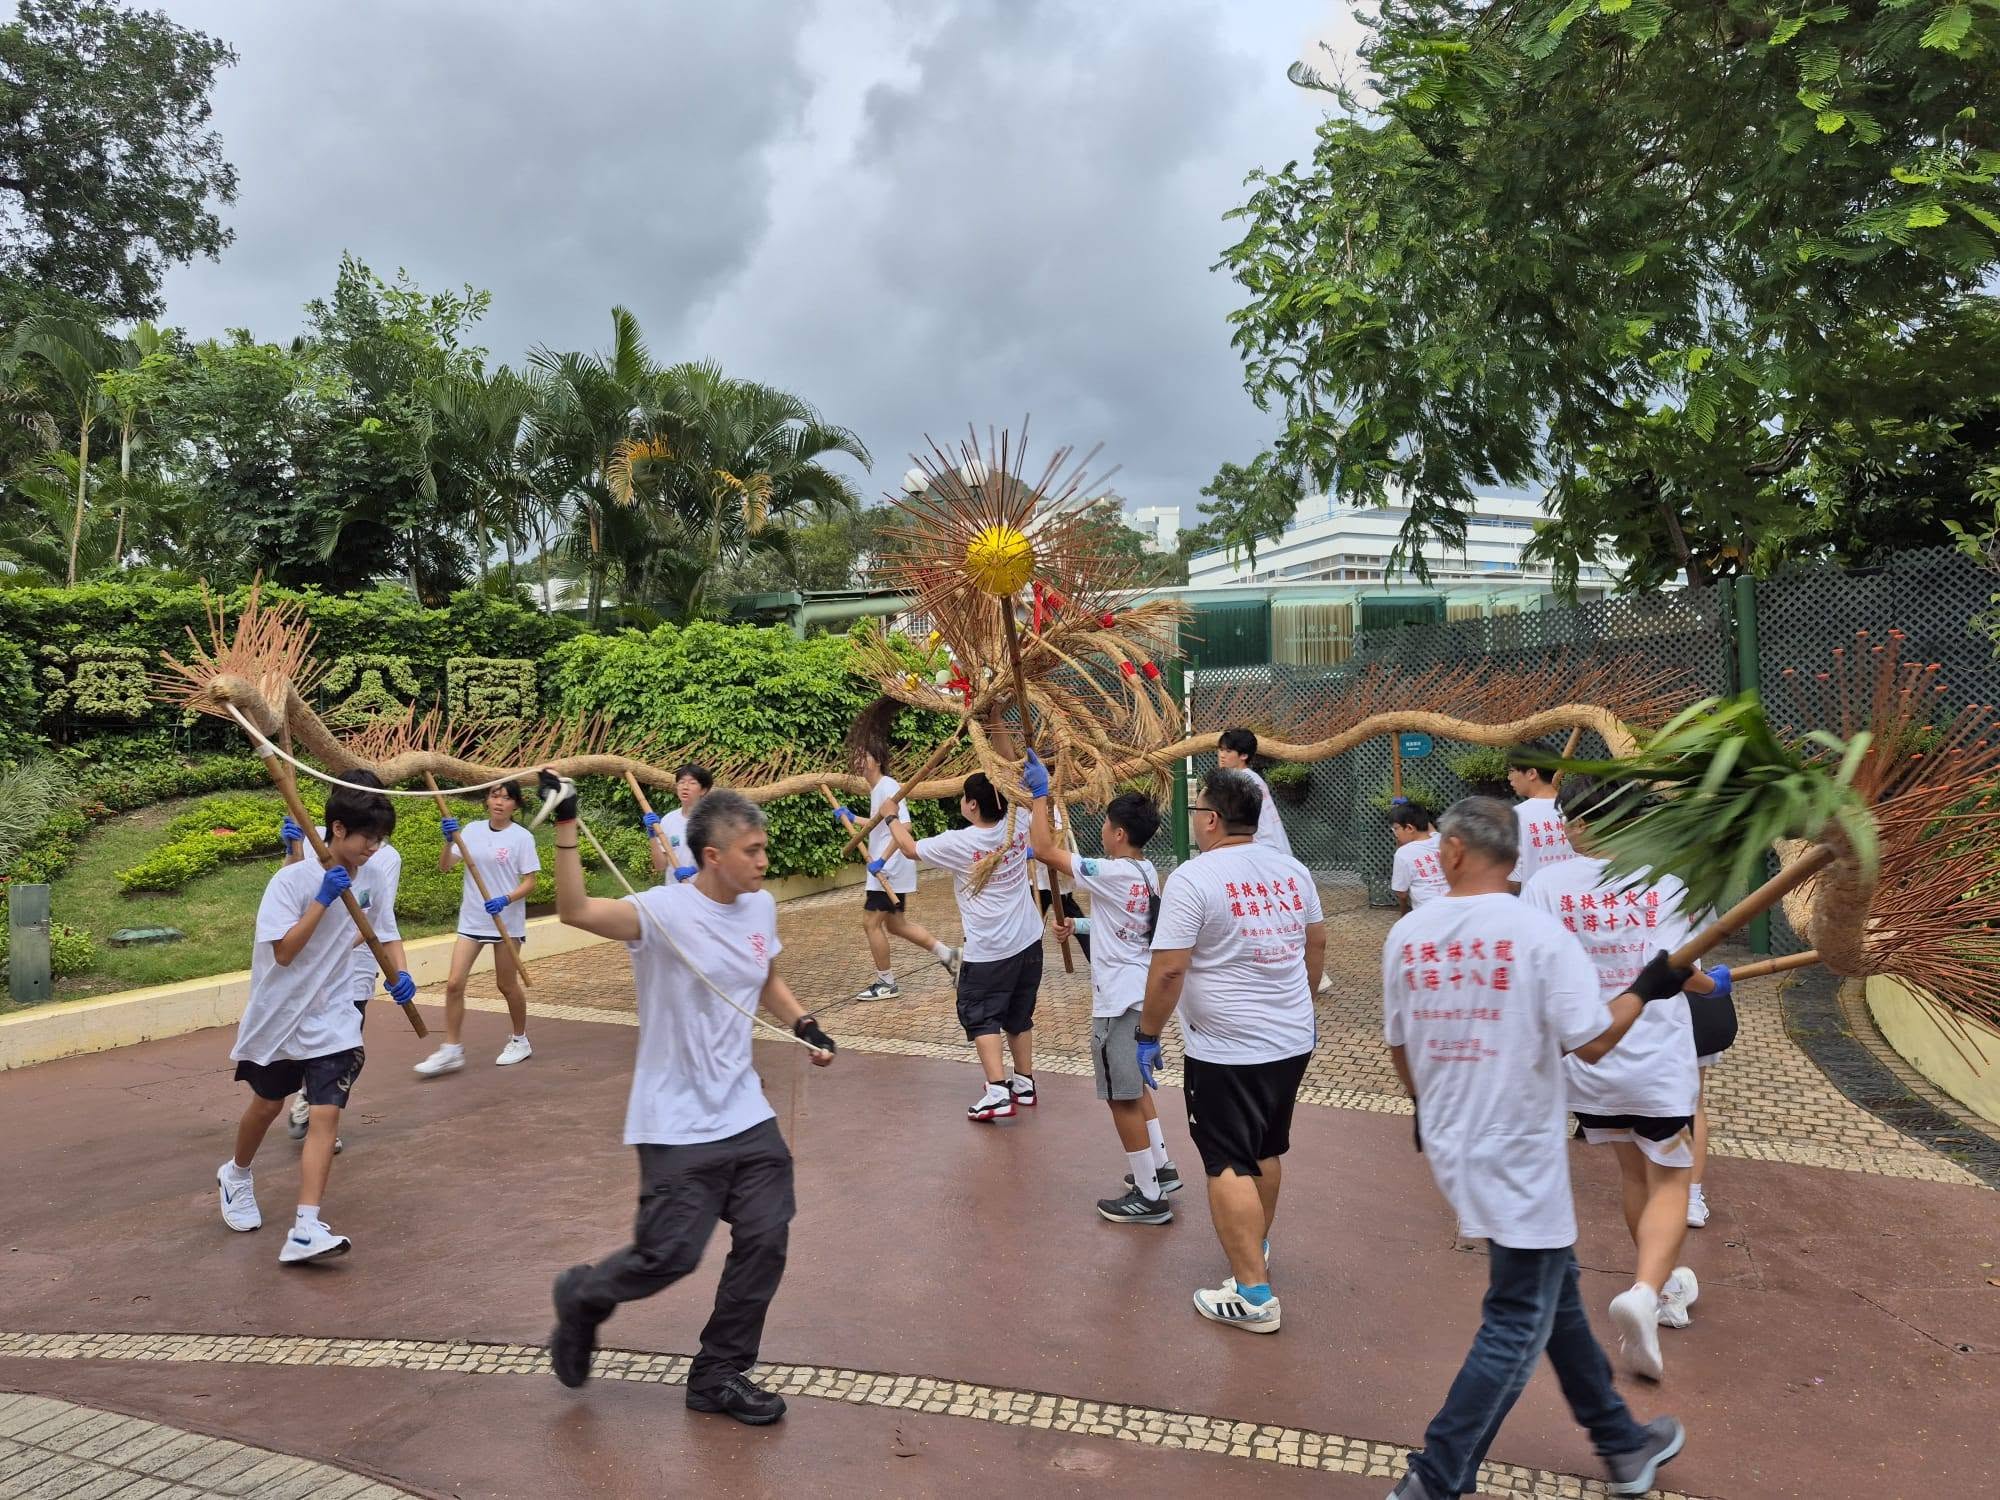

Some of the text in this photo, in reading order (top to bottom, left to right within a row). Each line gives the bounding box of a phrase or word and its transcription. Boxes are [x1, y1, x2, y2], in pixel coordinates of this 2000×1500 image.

[40, 642, 540, 728] 海公園
[1231, 894, 1303, 917] 龍游十八區
[1560, 891, 1660, 912] 薄扶林火龍
[1563, 911, 1657, 933] 龍游十八區
